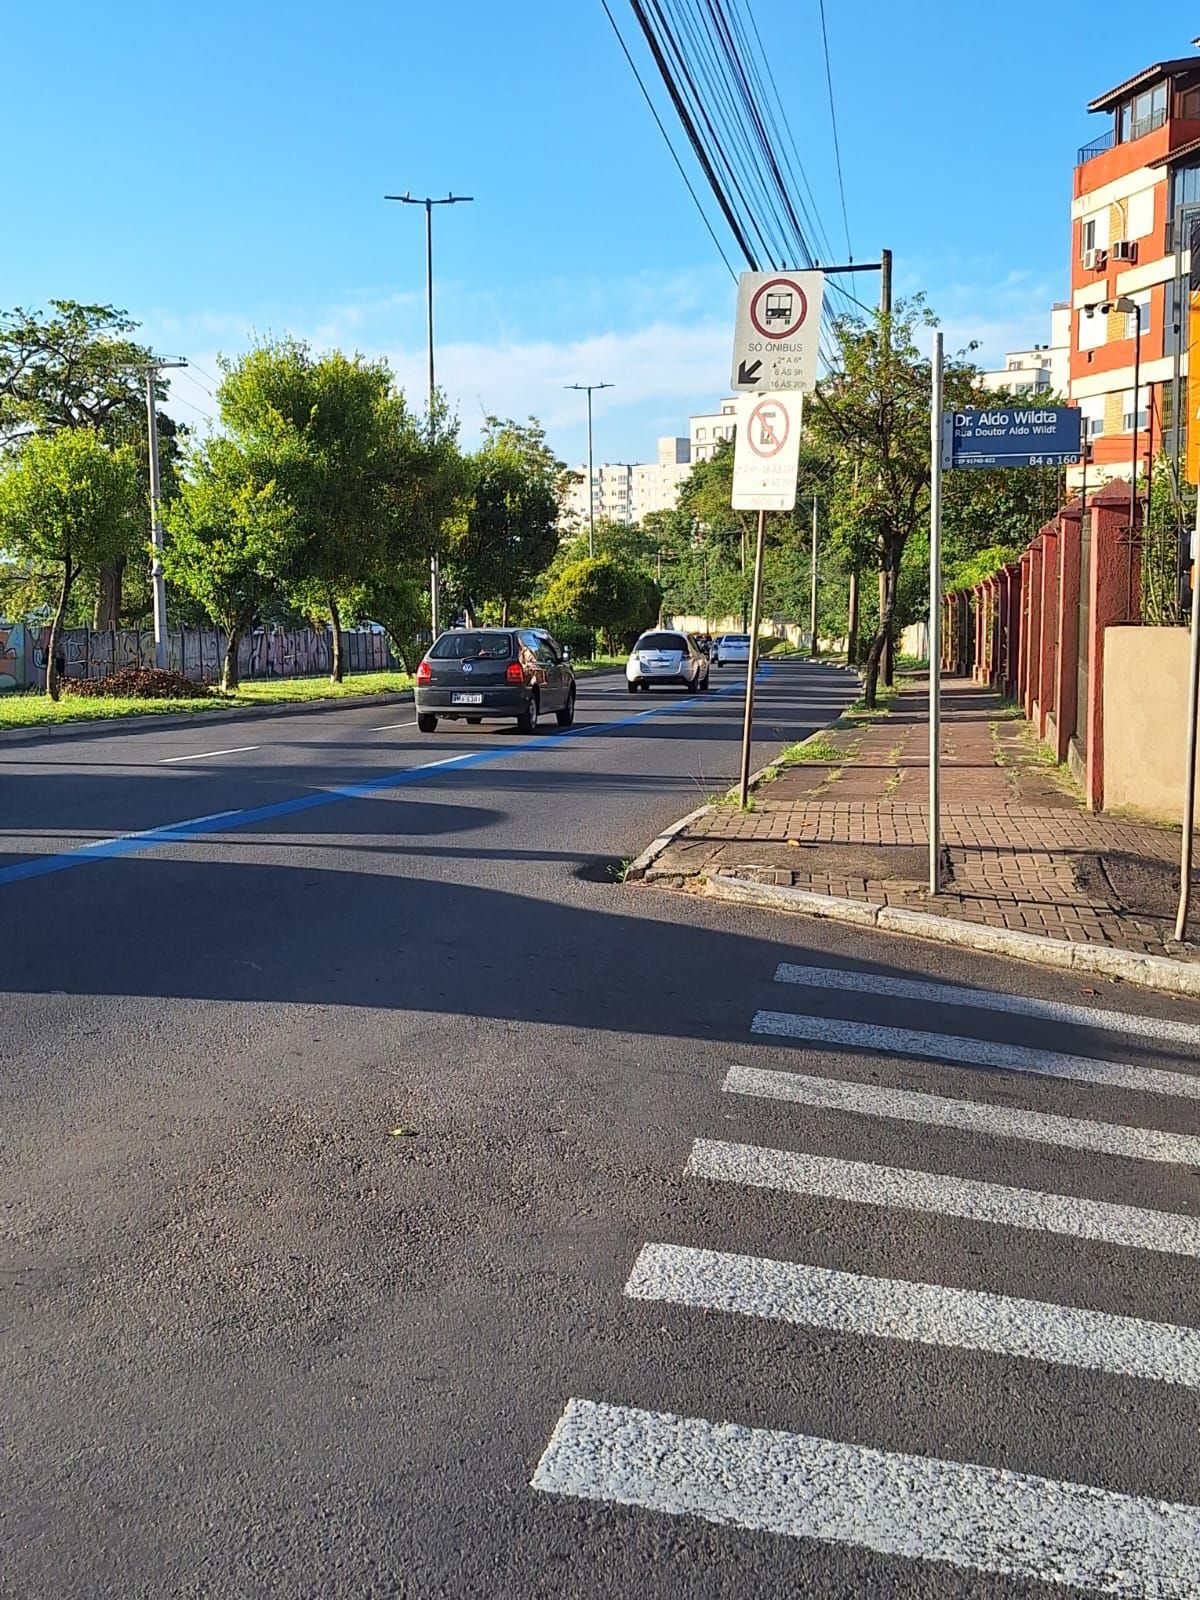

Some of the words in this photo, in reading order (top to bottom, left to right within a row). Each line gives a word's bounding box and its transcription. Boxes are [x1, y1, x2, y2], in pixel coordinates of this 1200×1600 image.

[748, 342, 763, 352] SÓ
[765, 342, 803, 352] ÔNIBUS
[955, 414, 973, 427] Dr.
[978, 412, 1009, 426] Aldo
[1014, 410, 1057, 424] Wildta
[955, 429, 972, 437] Rua
[975, 428, 1005, 437] Doutor
[1009, 426, 1030, 435] Aldo
[1032, 425, 1057, 434] Wildt
[1029, 456, 1043, 465] 84
[1057, 455, 1077, 464] 160
